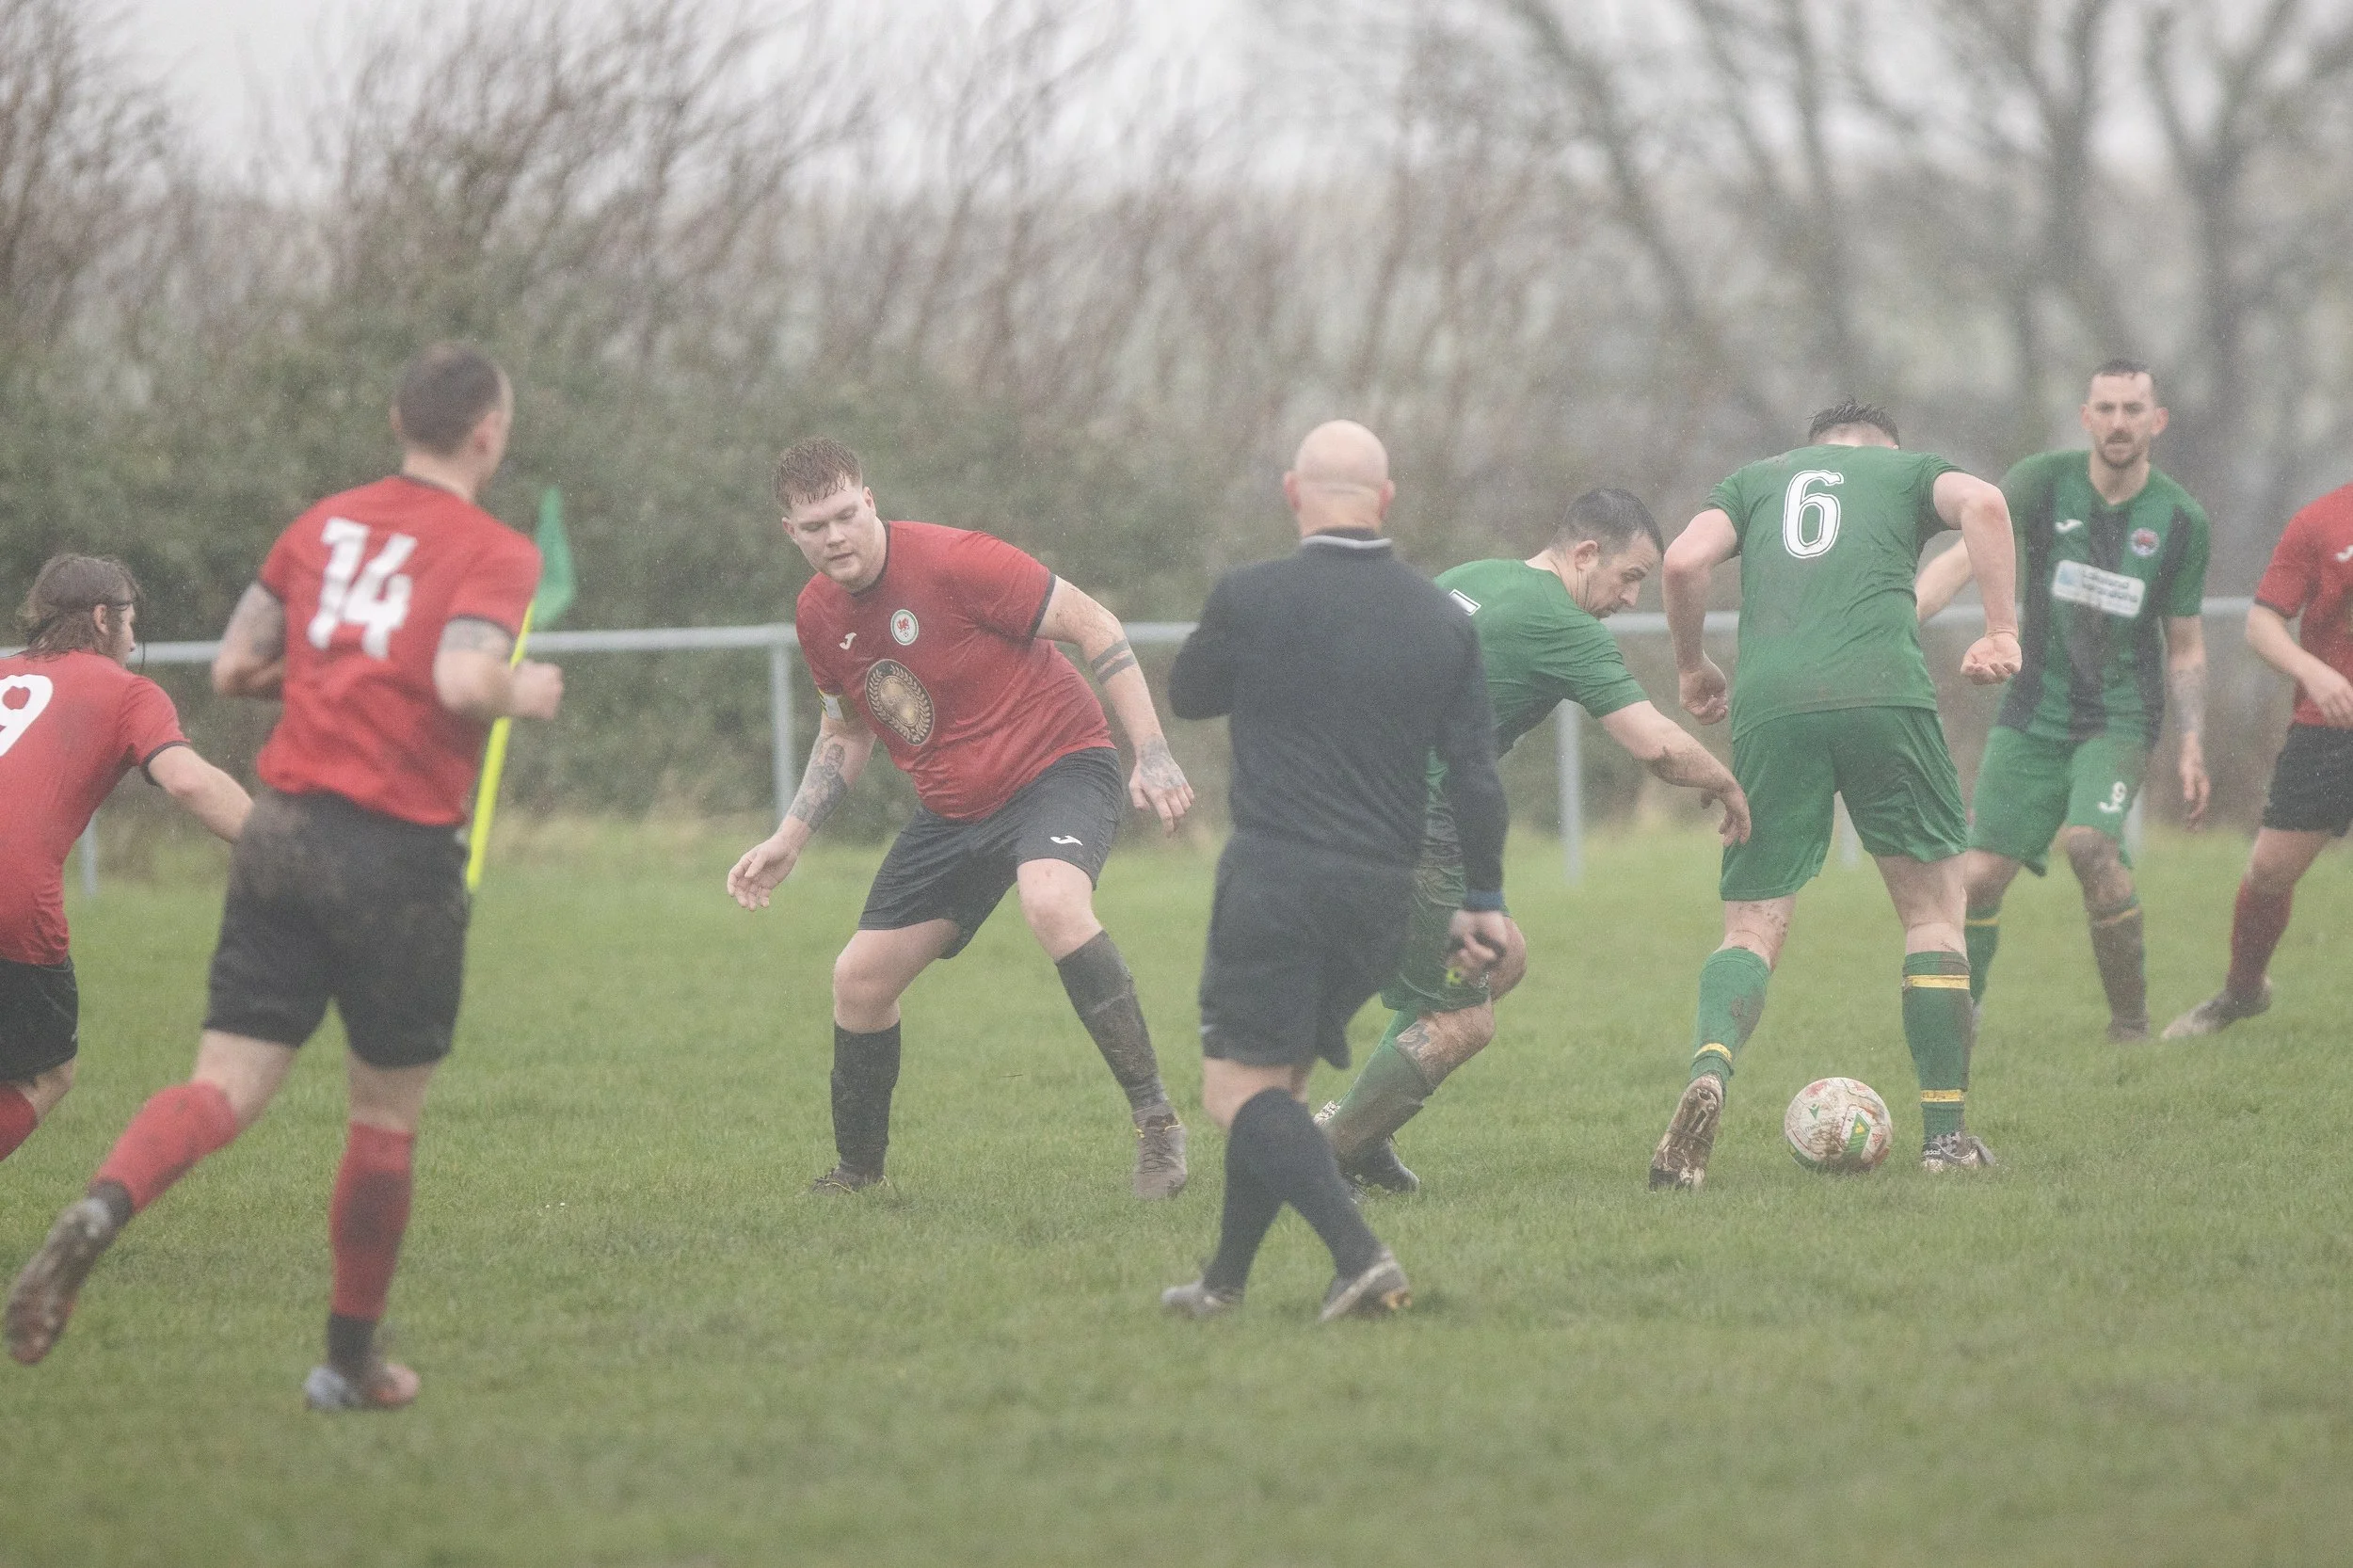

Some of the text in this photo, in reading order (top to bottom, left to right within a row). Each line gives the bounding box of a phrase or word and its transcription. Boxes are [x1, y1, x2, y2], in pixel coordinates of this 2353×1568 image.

[1783, 470, 1844, 559] 6
[305, 516, 418, 661] 14
[0, 673, 54, 757] 9
